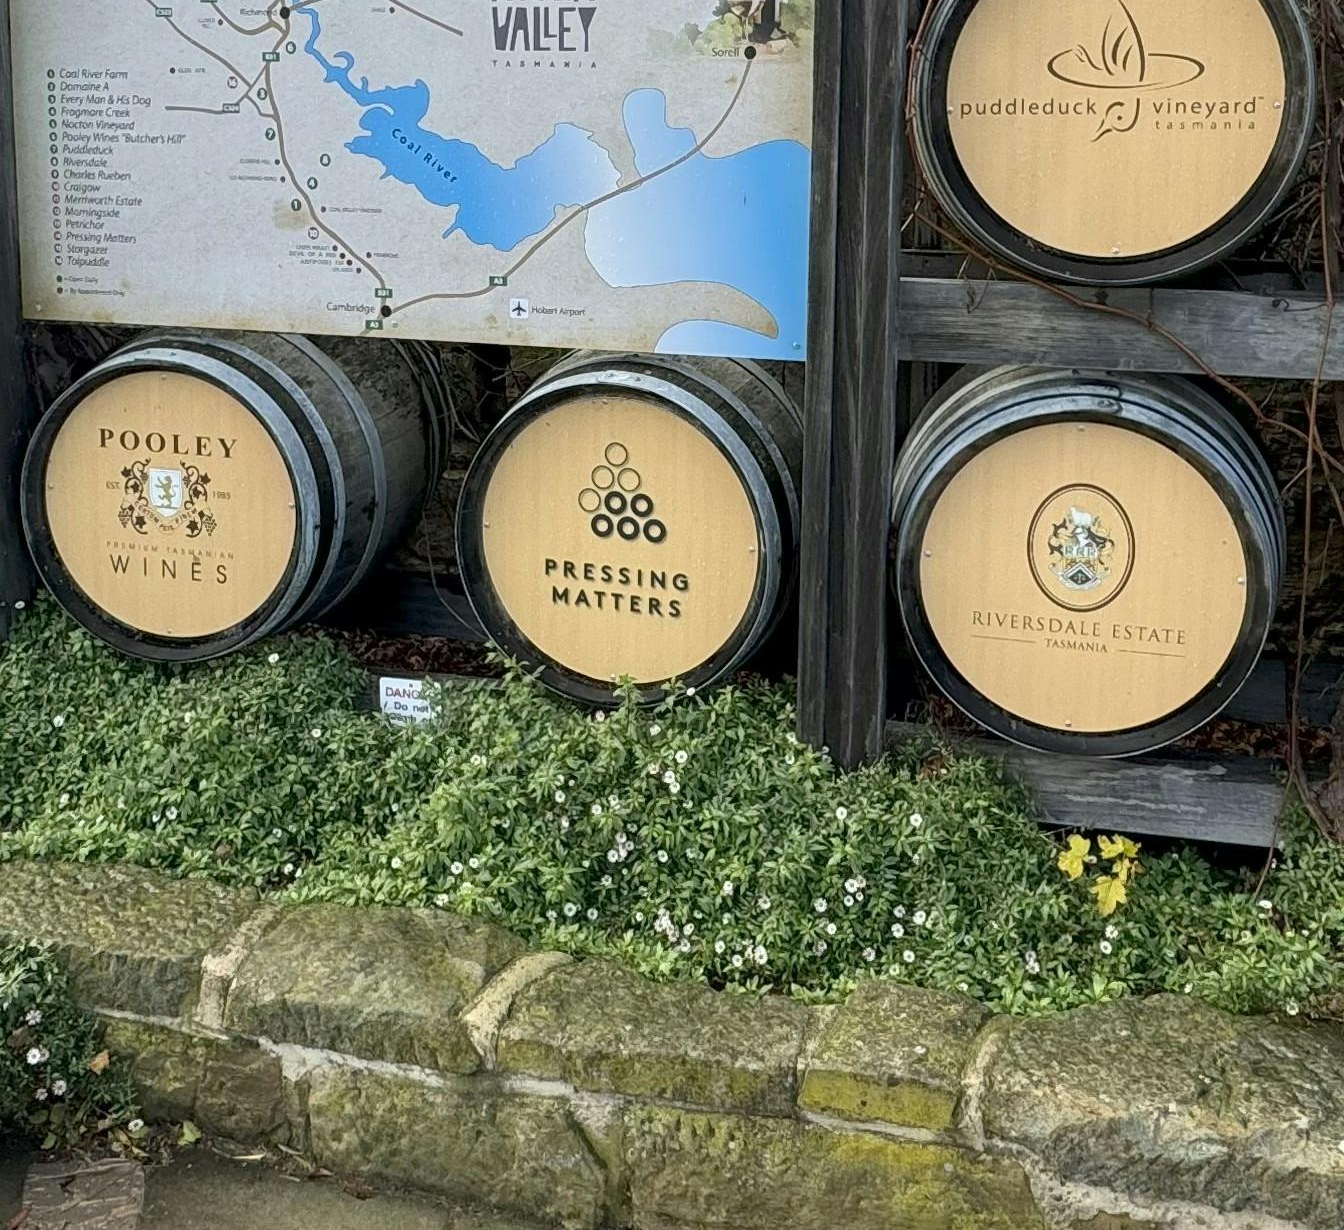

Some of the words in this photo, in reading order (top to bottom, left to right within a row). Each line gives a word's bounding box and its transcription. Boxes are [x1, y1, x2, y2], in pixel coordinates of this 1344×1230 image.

[492, 6, 597, 52] VALLEY
[711, 46, 740, 58] Sorell
[492, 59, 598, 69] TASMANIA
[59, 69, 79, 78] Coal
[82, 70, 103, 79] River
[105, 70, 128, 79] Farm
[60, 82, 101, 91] Domaine
[102, 82, 109, 91] A
[60, 94, 84, 105] Every
[86, 94, 105, 104] Man
[107, 94, 115, 104] &
[116, 94, 130, 105] His
[132, 95, 151, 107] Dog
[61, 107, 103, 118] Frogmore
[106, 107, 130, 117] Creek
[960, 98, 1097, 119] puddleduck
[62, 120, 93, 129] Nocton
[95, 120, 135, 131] Vineyard
[1155, 120, 1256, 131] tasmania
[62, 132, 91, 144] Pooley
[93, 132, 119, 143] Wines
[63, 144, 113, 155] Puddleduck
[391, 128, 421, 154] Coal
[423, 152, 458, 183] River
[63, 157, 108, 167] Riversdale
[64, 169, 96, 180] Charles
[64, 182, 101, 194] Craigow
[115, 196, 142, 206] Estate
[66, 233, 101, 244] Pressing
[103, 233, 137, 244] Matters
[326, 302, 376, 314] Cambridge
[559, 307, 586, 317] Airport
[98, 427, 238, 459] POOLEY
[109, 554, 228, 585] WINES
[545, 558, 689, 591] PRESSING
[552, 586, 682, 618] MATTERS
[972, 610, 1101, 638] RIVERSDALE
[1112, 624, 1186, 645] ESTATE
[1044, 638, 1108, 653] TASMANIA
[385, 686, 426, 700] DANG
[394, 702, 408, 711] Do
[413, 705, 429, 713] not
